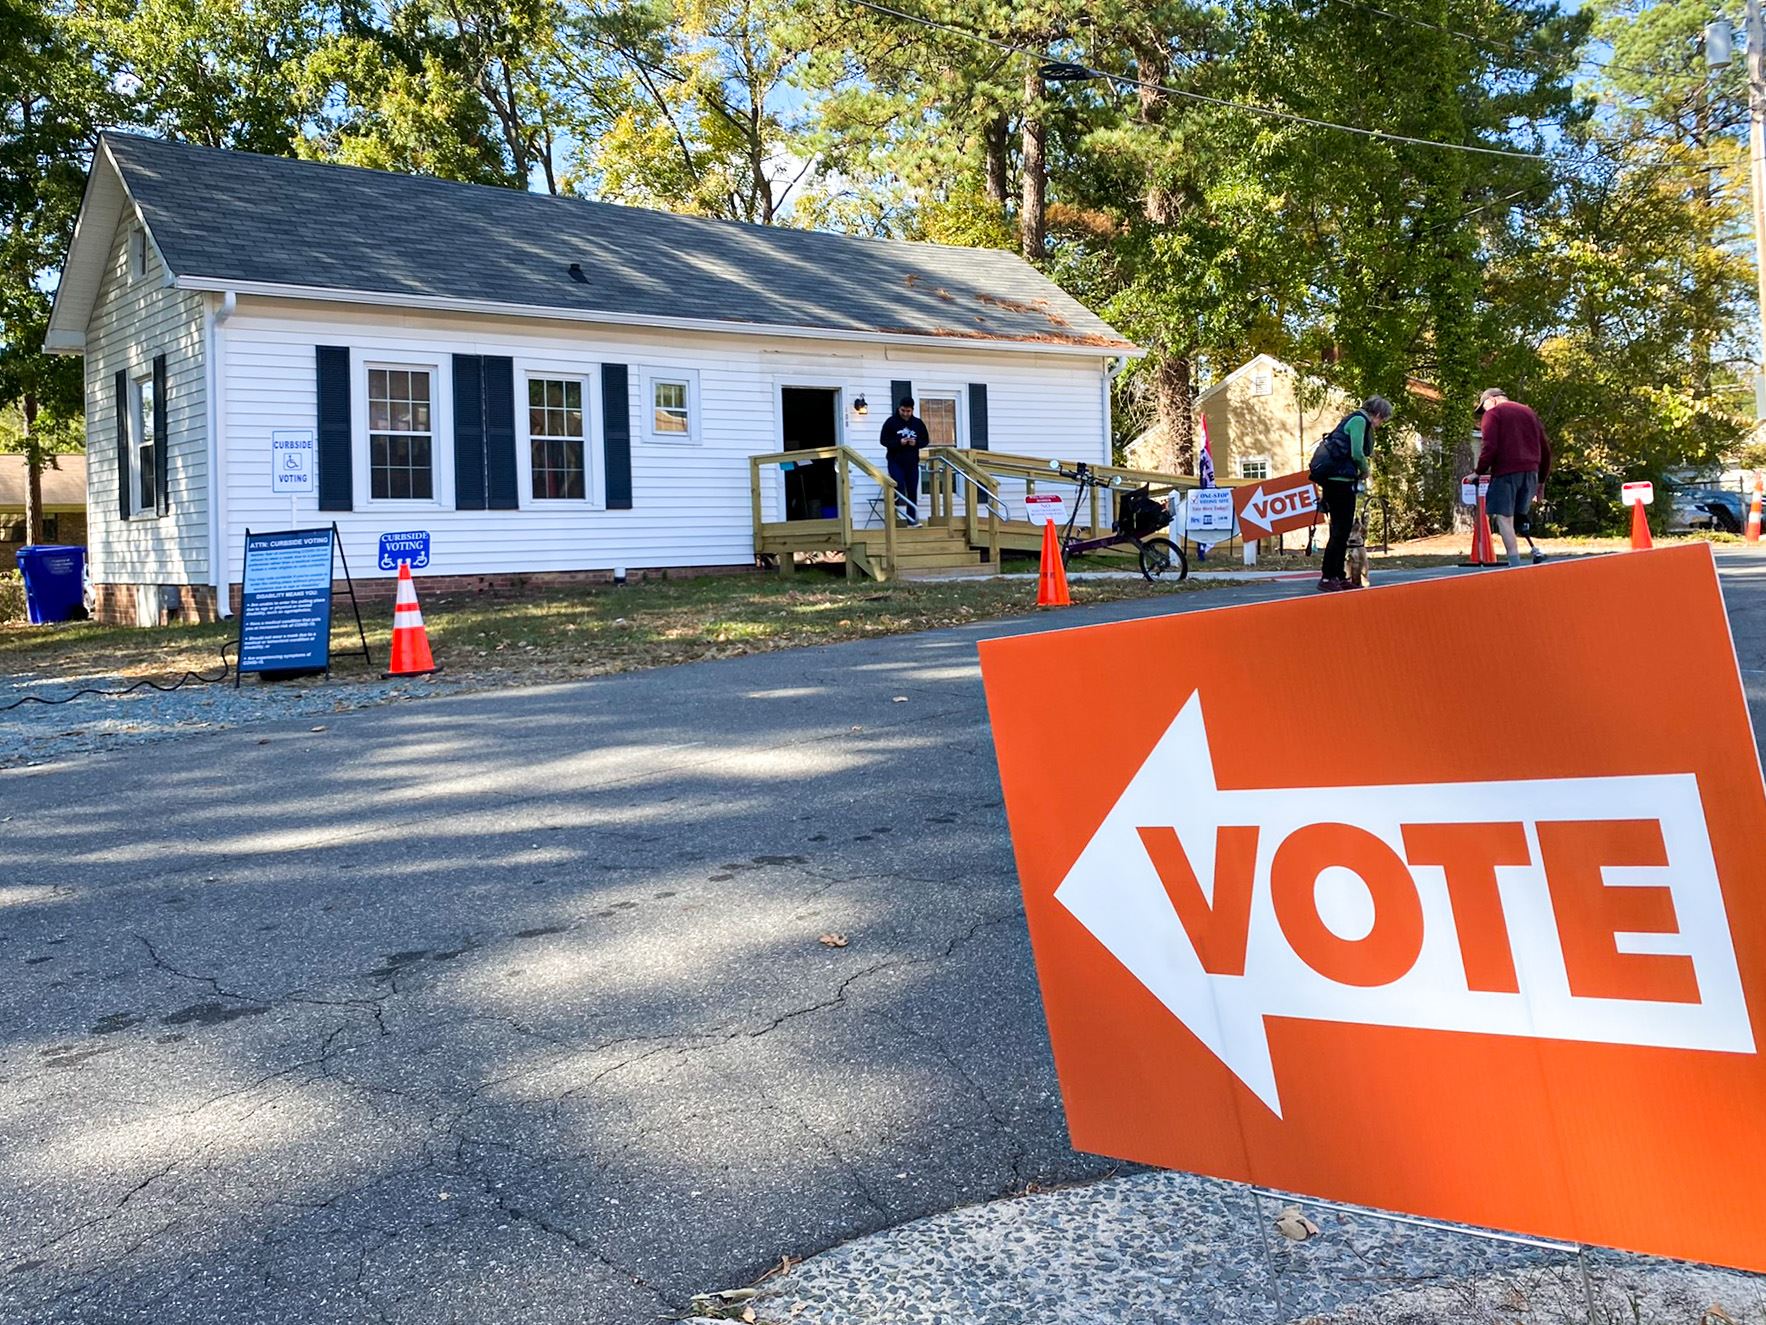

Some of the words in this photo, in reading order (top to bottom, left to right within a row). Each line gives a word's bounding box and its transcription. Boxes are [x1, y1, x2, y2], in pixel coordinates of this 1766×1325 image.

[273, 440, 312, 449] CURBSIDE
[279, 474, 307, 483] VOTING
[1252, 489, 1313, 519] VOTE
[270, 538, 302, 547] CURBSIDE
[303, 536, 328, 545] VOTING
[381, 531, 429, 542] CURBSIDE
[385, 541, 424, 551] VOTING
[1135, 818, 1703, 1005] VOTE
